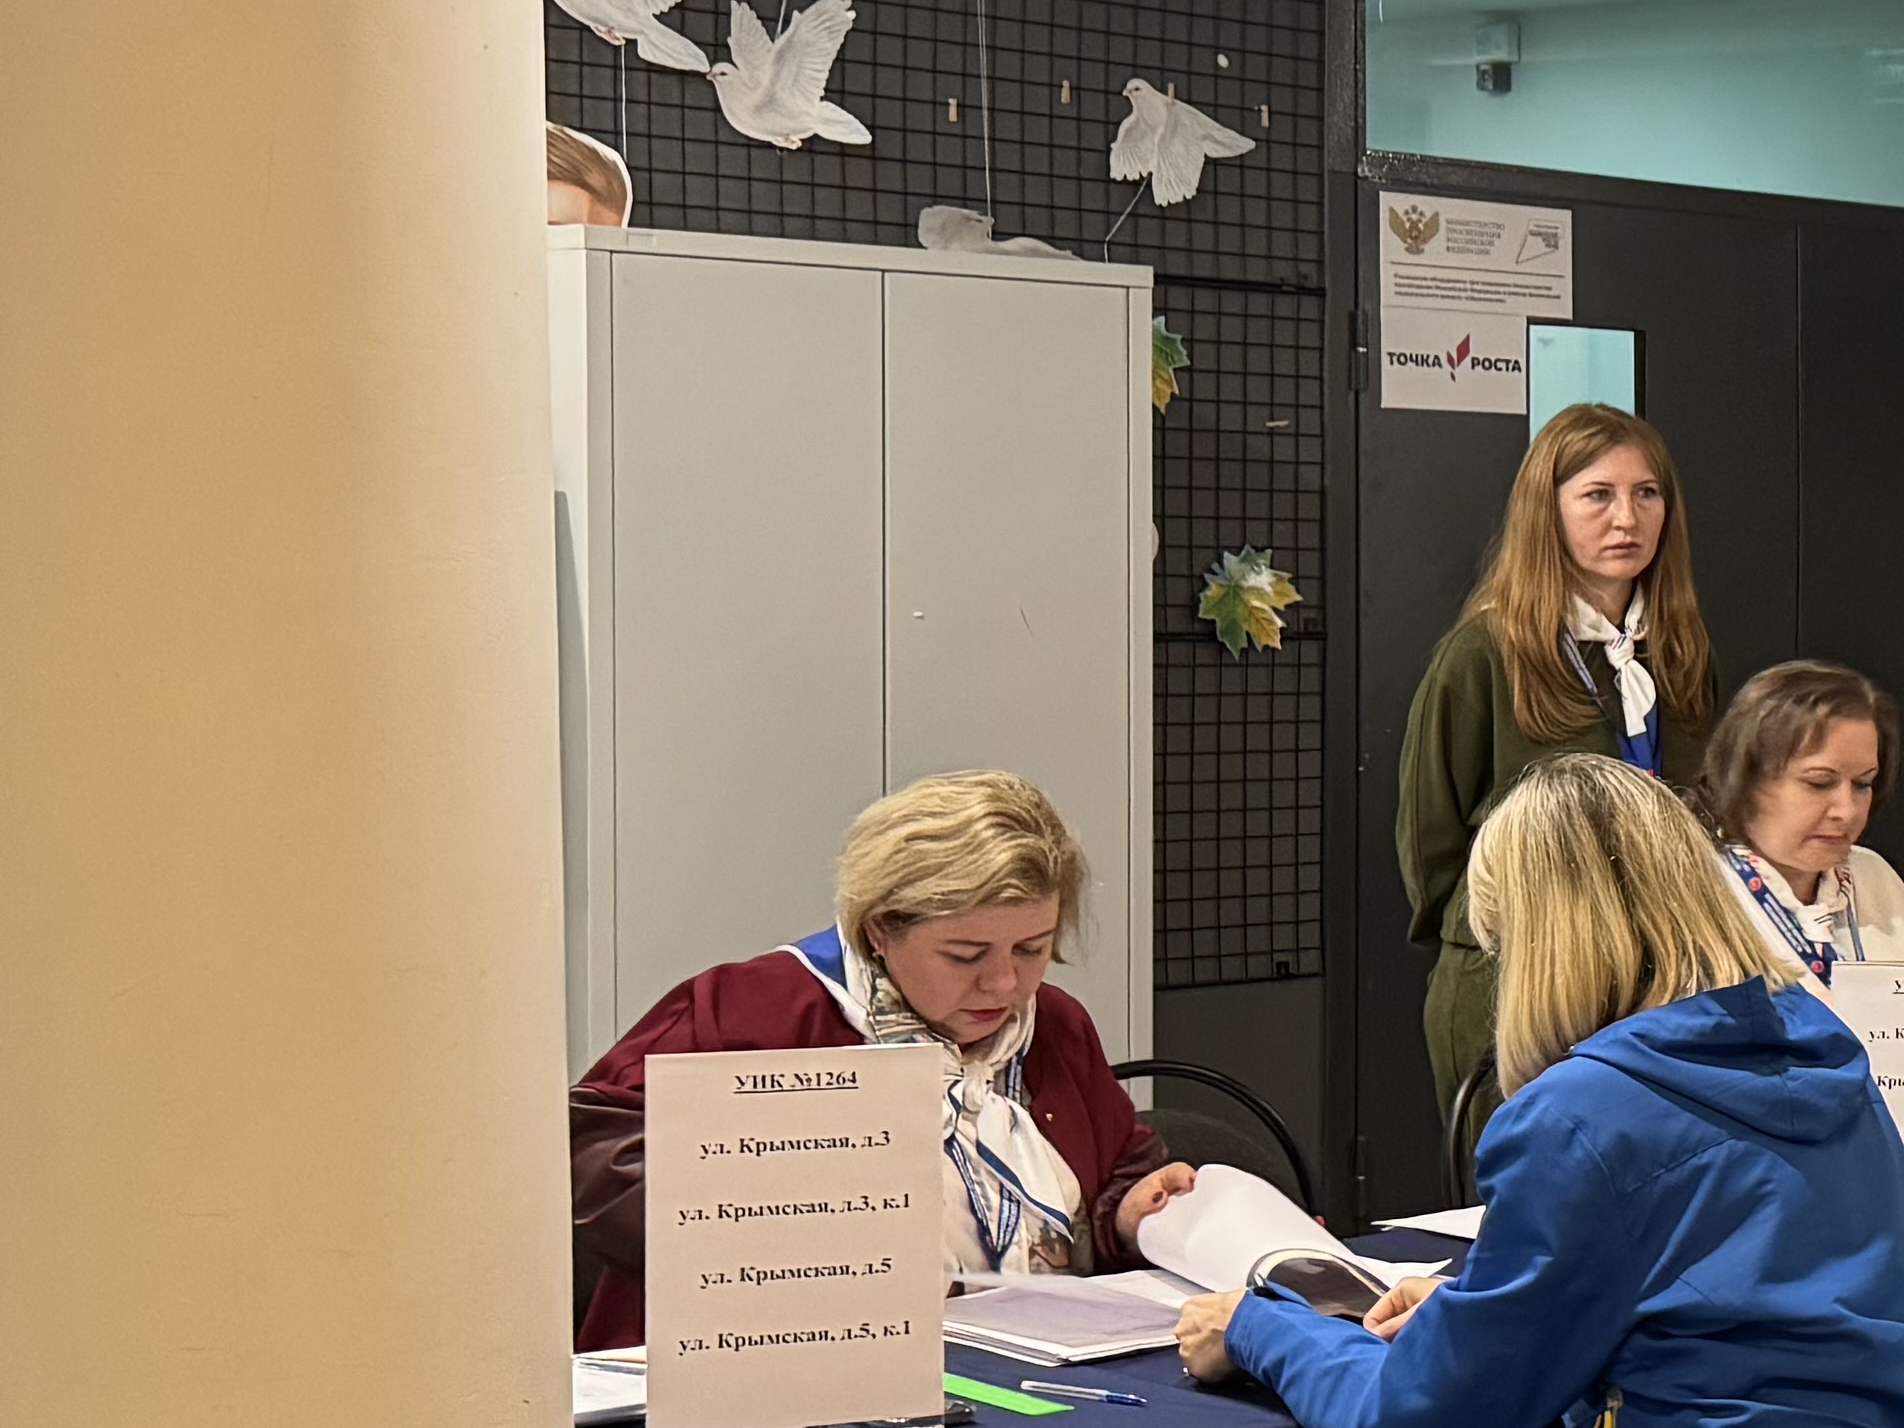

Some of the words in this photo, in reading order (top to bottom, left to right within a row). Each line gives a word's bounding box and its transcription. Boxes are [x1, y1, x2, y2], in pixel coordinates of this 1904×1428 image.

[1386, 351, 1443, 369] ТОЧКА
[1471, 356, 1522, 373] РОСТА
[1868, 1030, 1890, 1043] ул.
[733, 1073, 785, 1091] УИК
[790, 1071, 858, 1088] №1264
[699, 1143, 732, 1160] ул.
[739, 1136, 857, 1157] Крымская,
[860, 1130, 891, 1148] д.3
[678, 1209, 711, 1226] ул.
[717, 1201, 836, 1223] Крымская,
[839, 1195, 877, 1213] д.3,
[883, 1193, 910, 1210] к.1
[699, 1272, 733, 1290] ул.
[739, 1264, 858, 1286] Крымская,
[861, 1257, 892, 1276] д.5
[678, 1339, 711, 1357] ул.
[718, 1329, 836, 1353] Крымская,
[840, 1322, 877, 1341] д.5,
[883, 1320, 911, 1337] к.1
